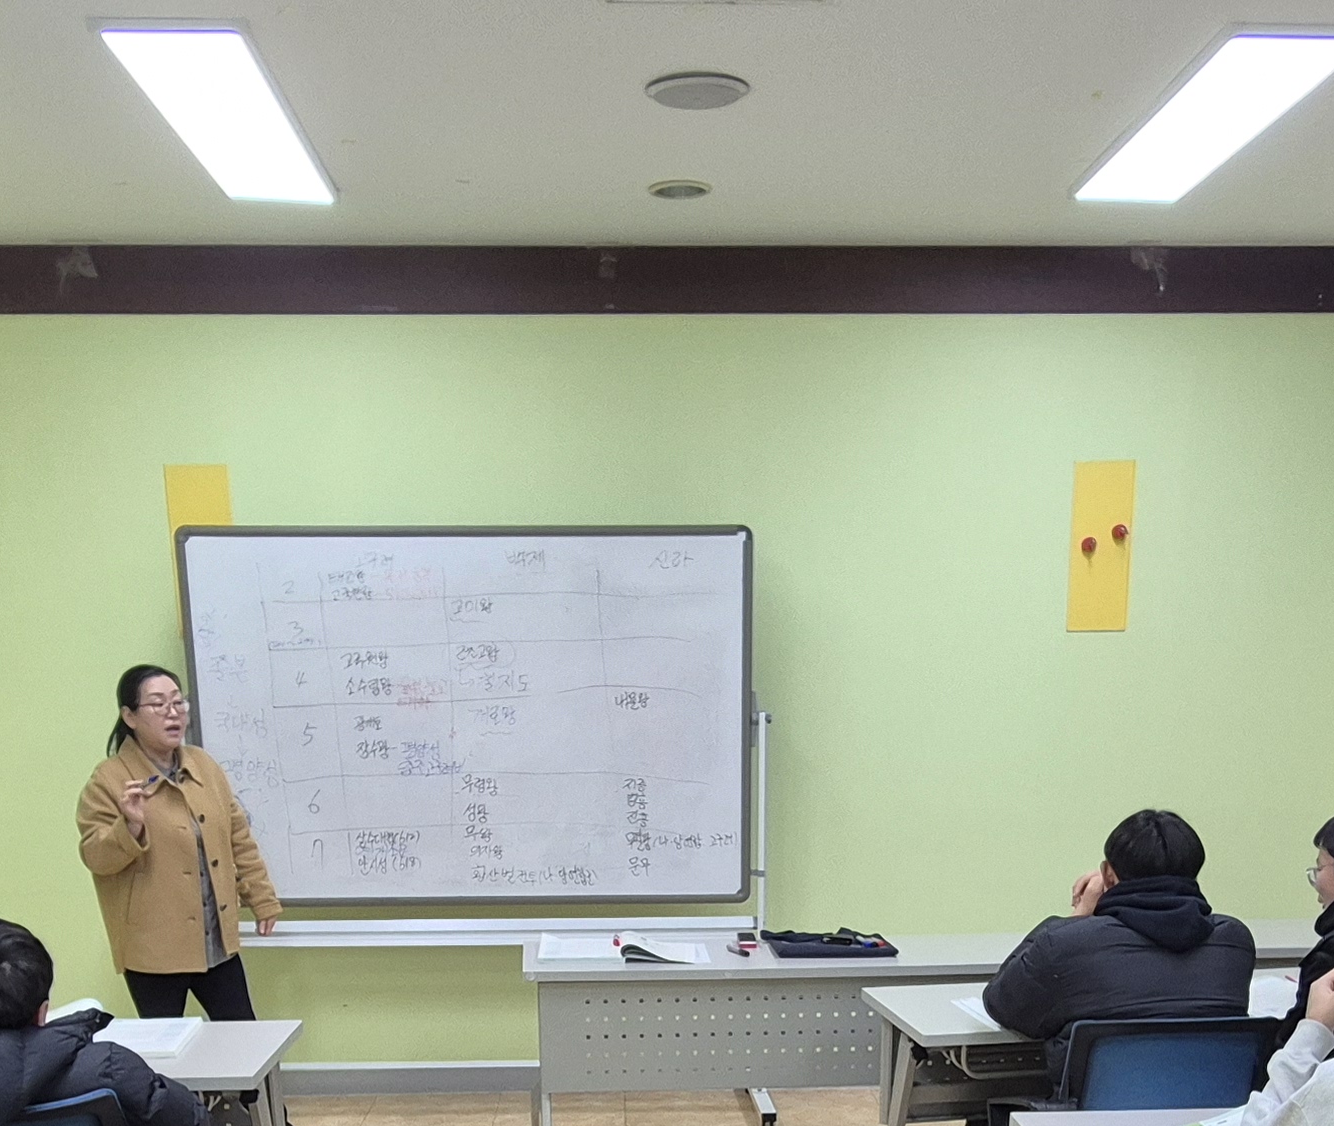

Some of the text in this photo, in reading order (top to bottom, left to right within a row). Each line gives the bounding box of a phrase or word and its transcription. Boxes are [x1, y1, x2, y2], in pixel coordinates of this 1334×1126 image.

[648, 550, 694, 569] 신라
[284, 581, 295, 594] 2
[451, 598, 493, 615] 고이왕
[288, 621, 304, 637] 3
[295, 672, 307, 687] 4
[346, 677, 392, 697] 소수림왕
[303, 723, 317, 746] 5
[461, 773, 499, 797] 무령왕
[308, 789, 321, 814] 6
[463, 802, 490, 824] 성왕
[464, 825, 494, 843] 무왕
[311, 839, 323, 869] 7
